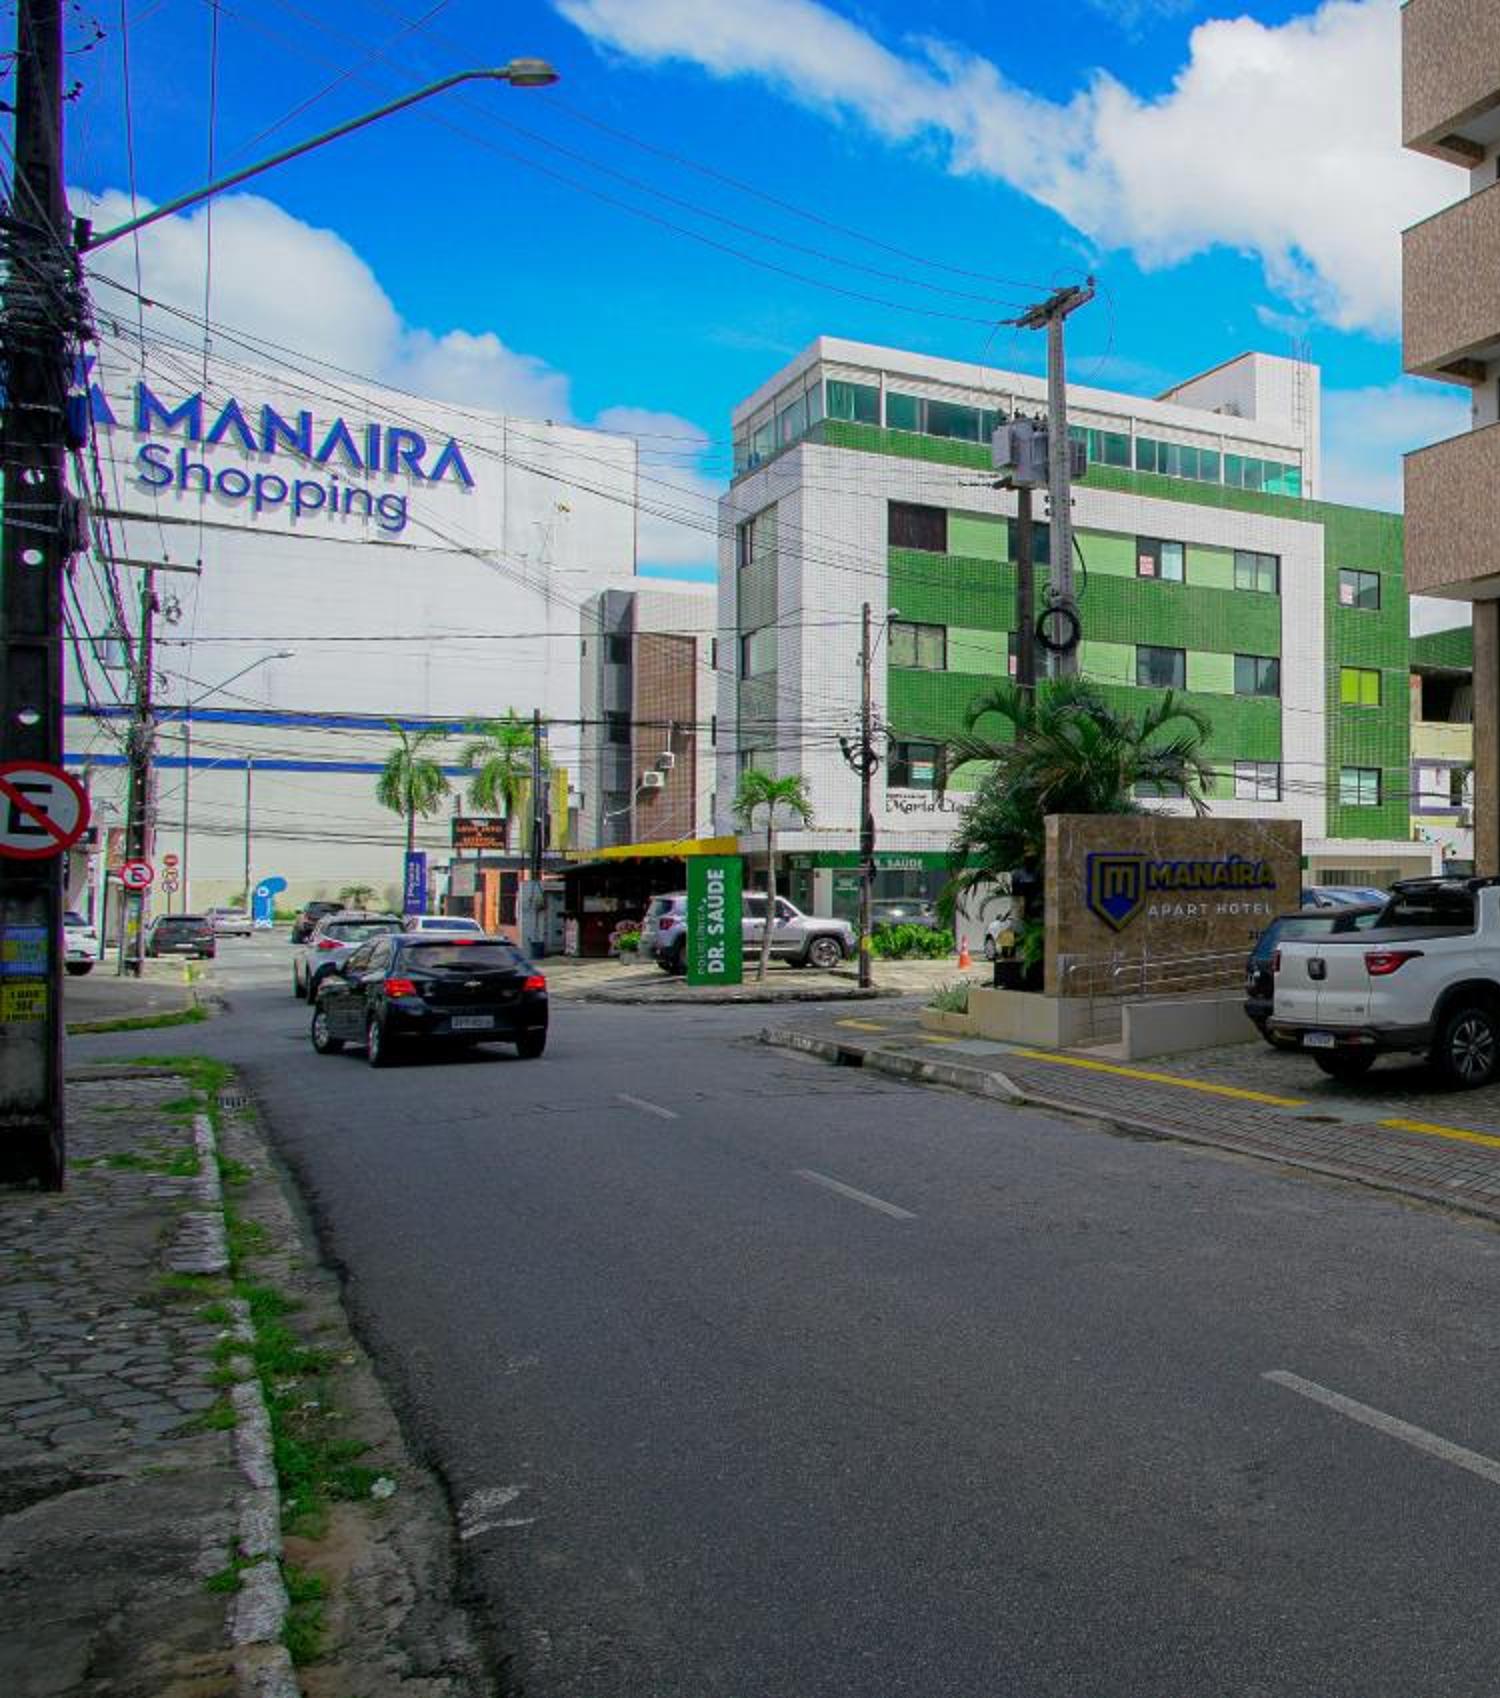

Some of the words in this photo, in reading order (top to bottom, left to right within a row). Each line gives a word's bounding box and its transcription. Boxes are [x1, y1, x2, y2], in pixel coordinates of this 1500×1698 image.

[138, 443, 407, 532] Shopping
[1148, 904, 1208, 917] APART
[1216, 902, 1271, 915] HOTEL
[707, 941, 725, 973] DR.
